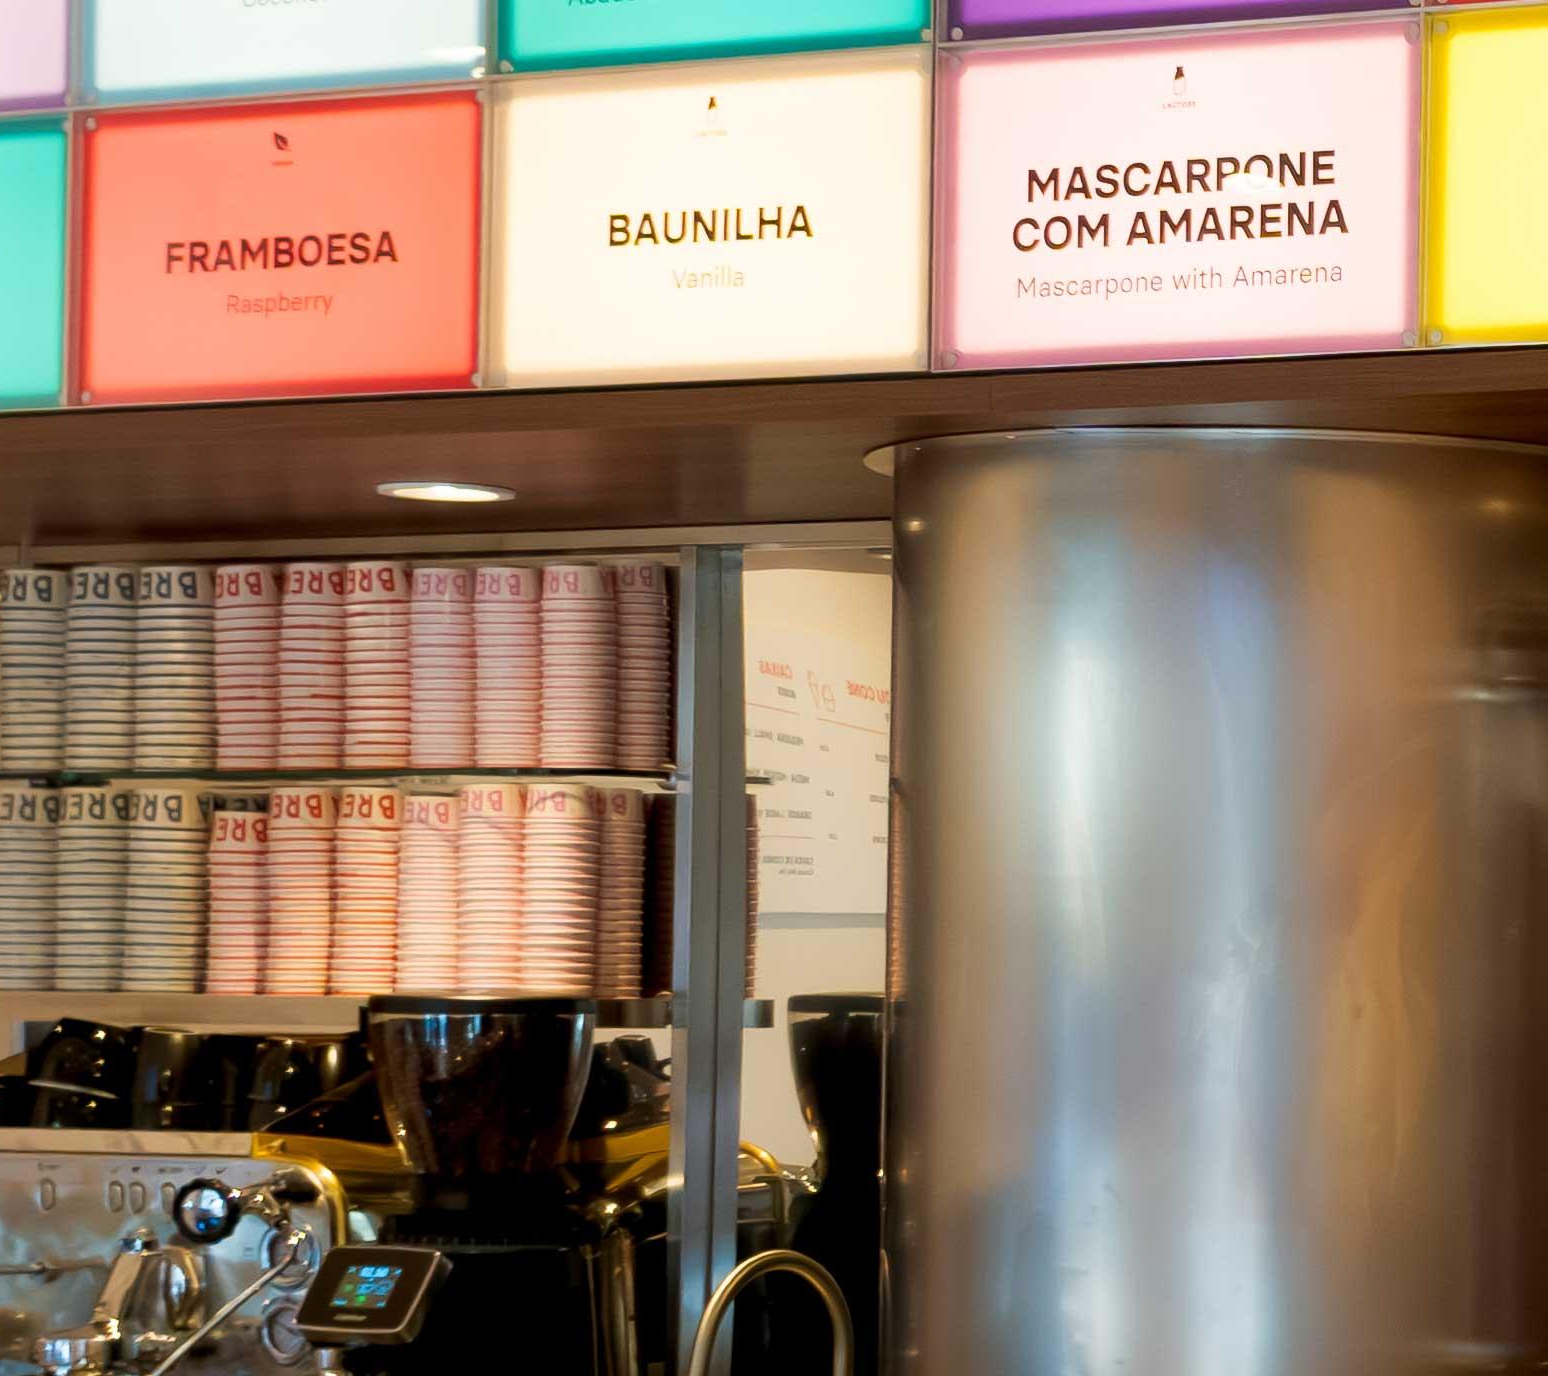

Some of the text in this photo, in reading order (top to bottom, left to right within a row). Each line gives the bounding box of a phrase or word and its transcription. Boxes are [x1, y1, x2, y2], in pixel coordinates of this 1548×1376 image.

[608, 206, 812, 246] BAUNILHA
[1011, 200, 1348, 251] COM AMARENA
[165, 231, 397, 273] FRAMBOESA
[672, 267, 744, 288] Vanilla
[1016, 262, 1341, 300] Mascarpone with Amarena
[225, 292, 333, 320] Raspberry
